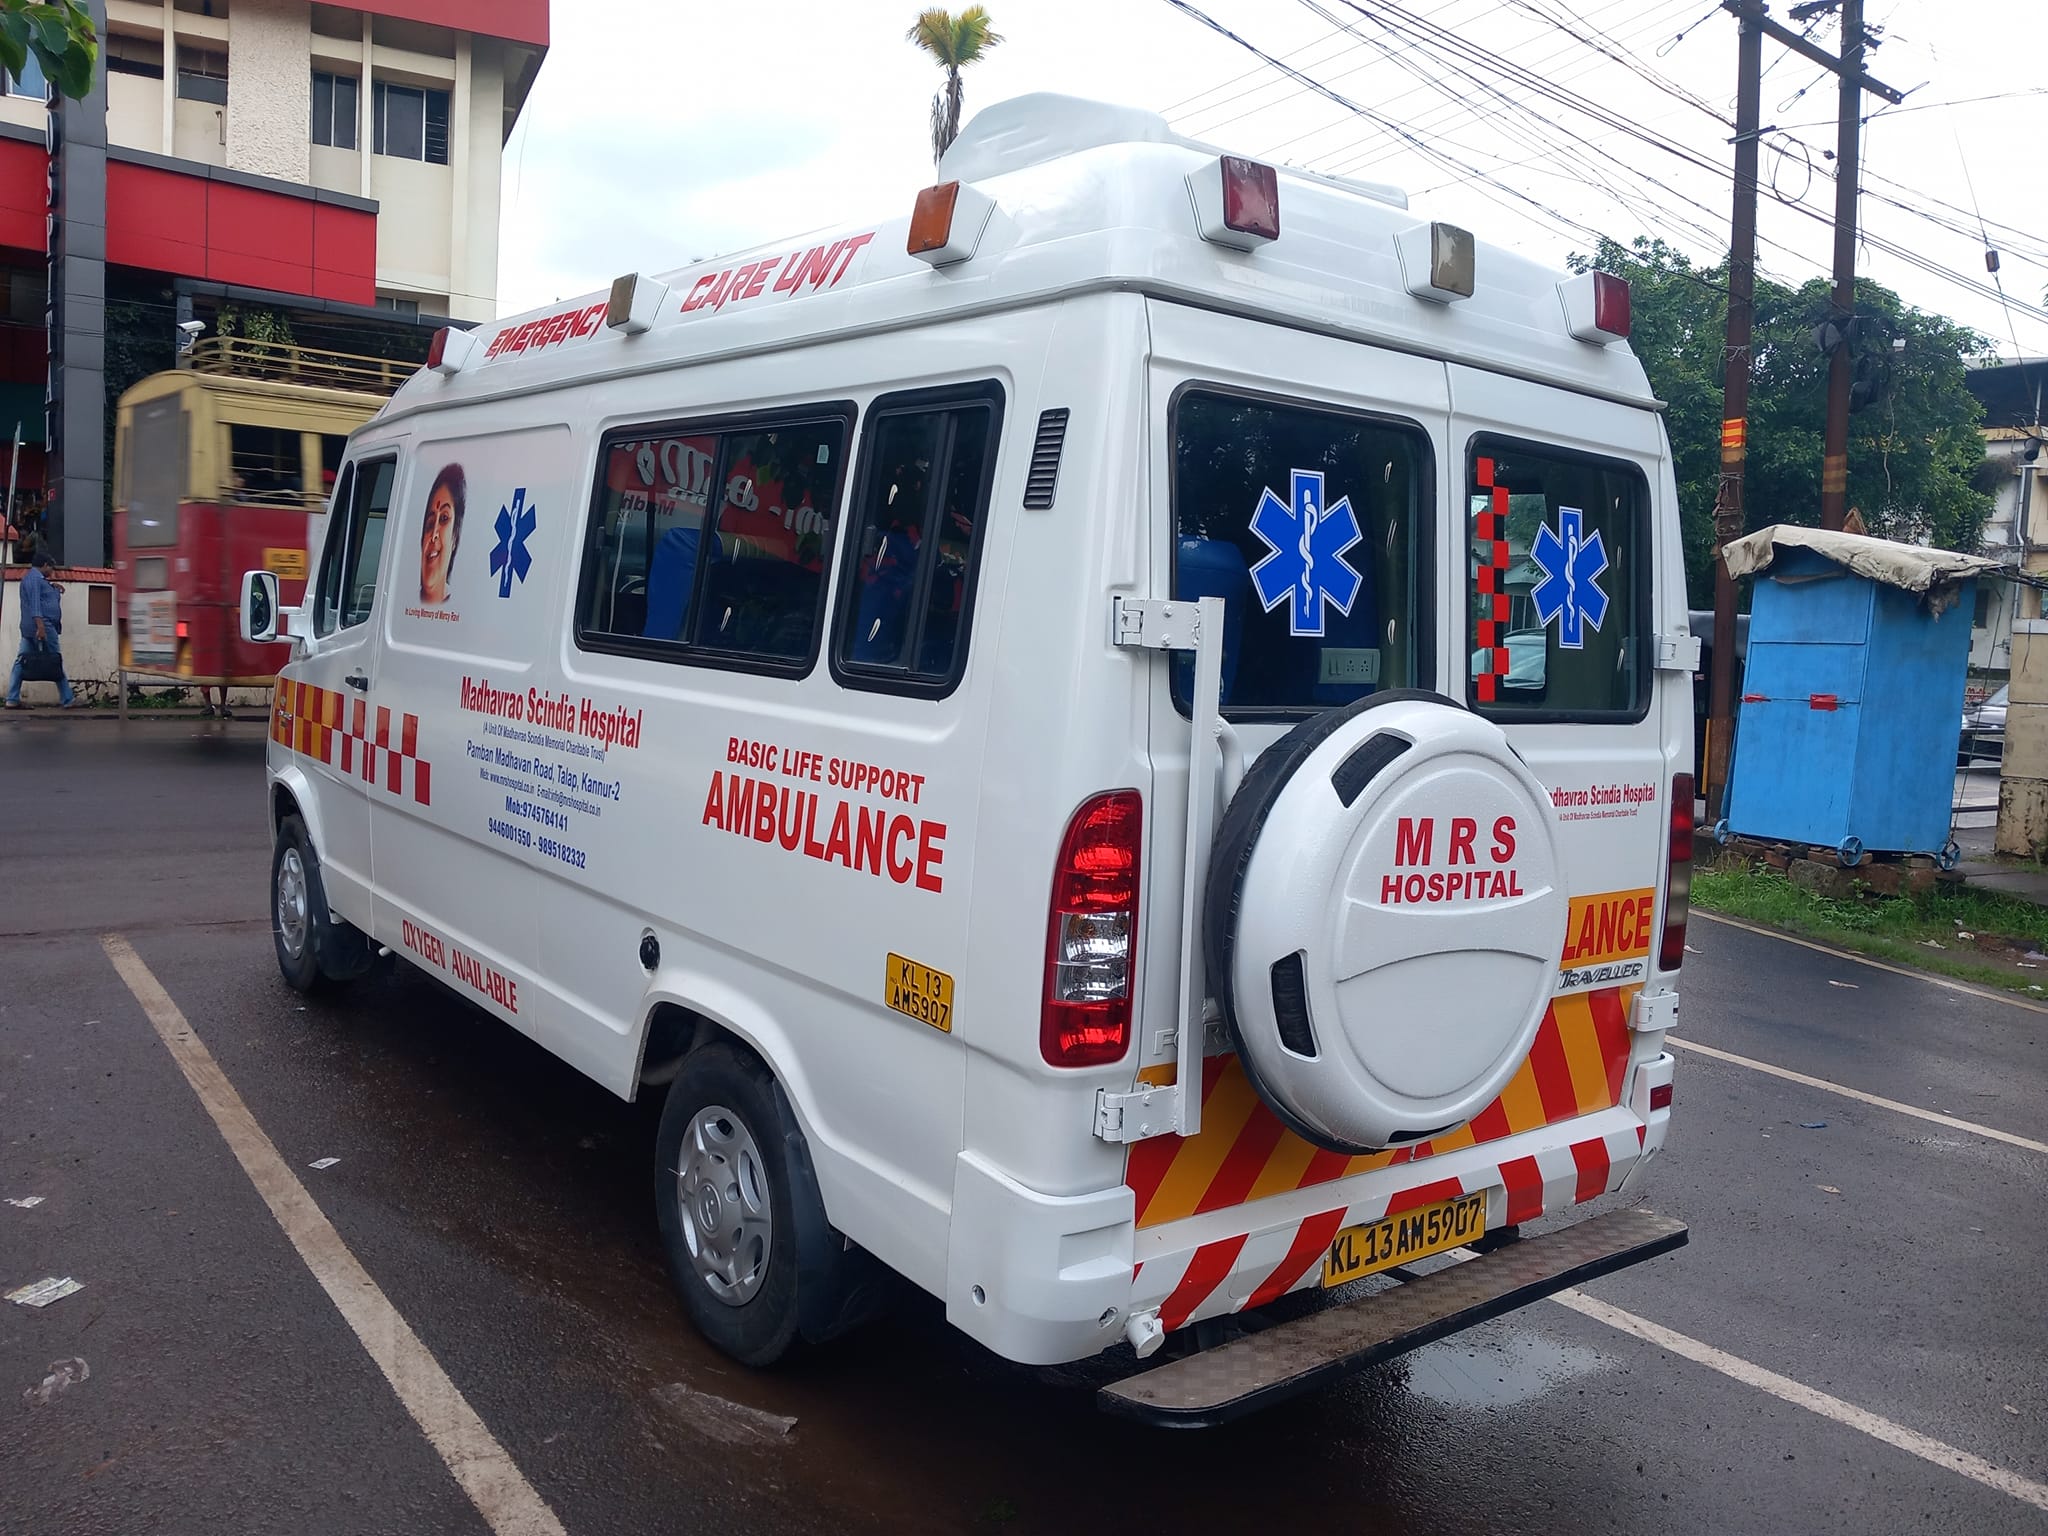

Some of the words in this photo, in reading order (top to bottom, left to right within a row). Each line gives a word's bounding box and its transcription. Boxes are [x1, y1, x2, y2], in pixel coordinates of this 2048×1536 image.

[680, 257, 782, 314] CARE
[772, 232, 876, 297] UNIT
[460, 676, 523, 721] Madhavrao
[527, 687, 576, 734] Scindia
[579, 698, 642, 752] Hospital
[467, 739, 494, 763] Pamban
[495, 747, 532, 774] Madhavan
[533, 757, 555, 785] Road,
[557, 764, 580, 792] Talap,
[581, 772, 620, 801] Kannur-2
[727, 736, 778, 772] BASIC
[782, 748, 823, 782] LIFE
[828, 757, 925, 805] SUPPORT
[1590, 784, 1621, 805] Scindia
[1623, 782, 1655, 807] Hospital
[505, 796, 568, 832] Mob:9745764141
[702, 770, 947, 894] AMBULANCE
[488, 817, 531, 848] 9446001550
[538, 836, 586, 869] 9895182332
[1381, 870, 1523, 904] HOSPITAL
[402, 919, 446, 970] OXYGEN
[452, 948, 518, 1015] AVAILABLE
[902, 961, 919, 990] KL
[926, 971, 941, 997] 13
[1559, 962, 1643, 989] TRAVELLER
[893, 985, 948, 1027] AM5907
